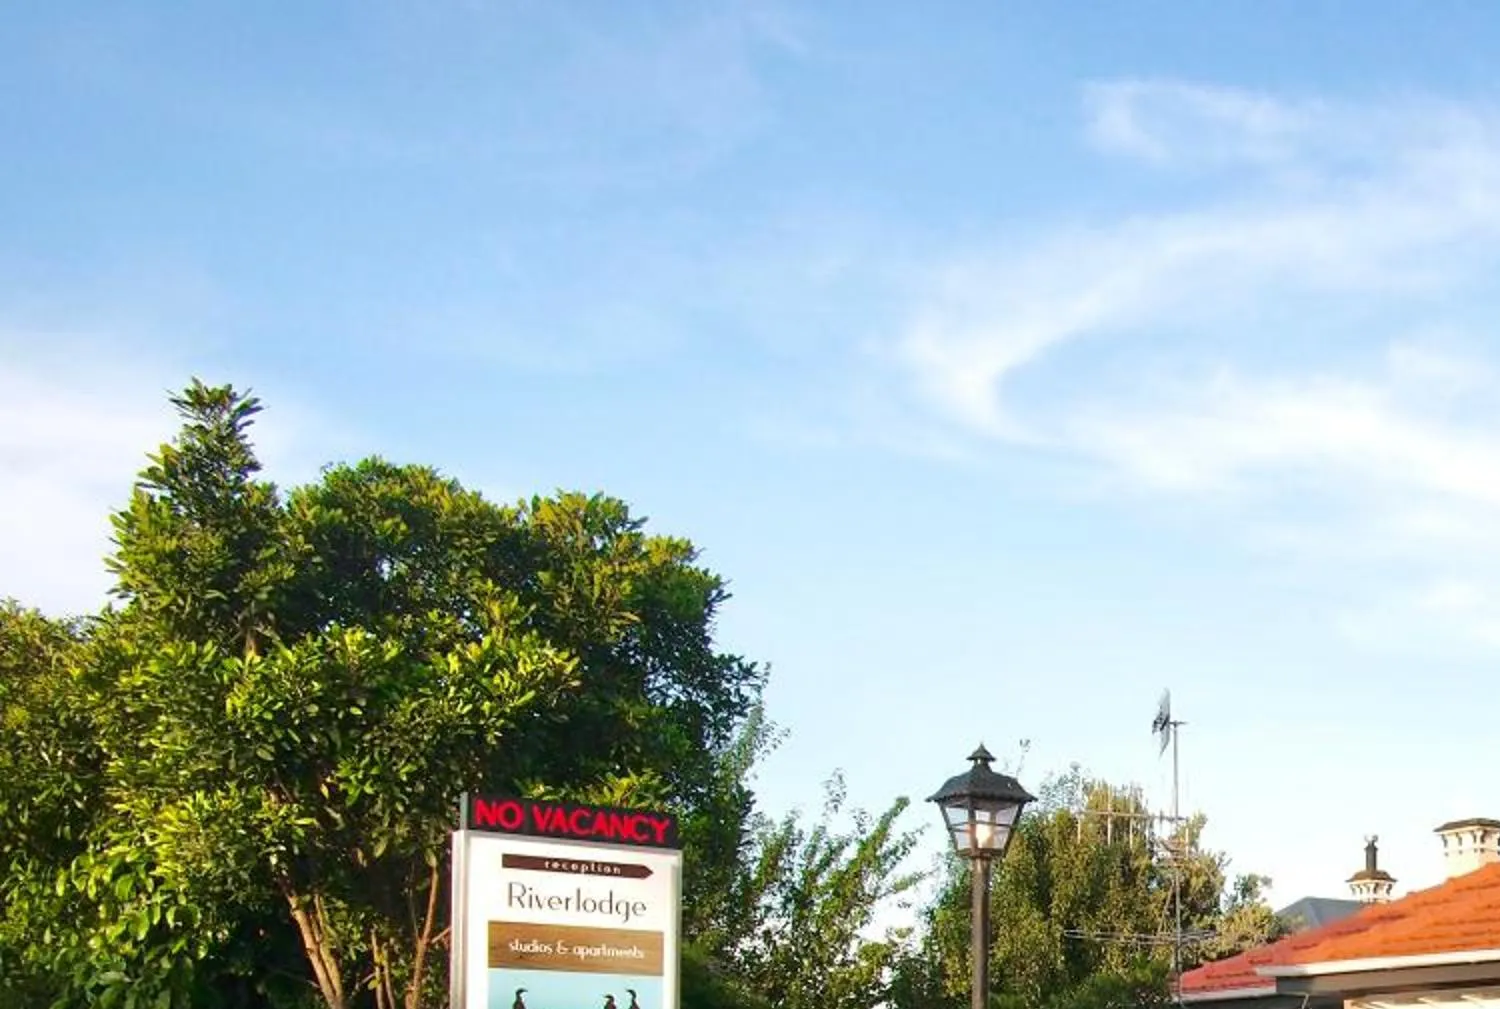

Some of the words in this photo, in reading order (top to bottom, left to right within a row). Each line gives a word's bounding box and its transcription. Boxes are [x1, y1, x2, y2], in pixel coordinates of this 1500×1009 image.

[475, 799, 523, 829] NO
[532, 805, 670, 843] VACANCY
[544, 861, 621, 874] reception
[508, 882, 647, 923] Riverlodge
[508, 939, 553, 953] studios
[556, 939, 569, 955] &
[573, 943, 645, 960] apartments
